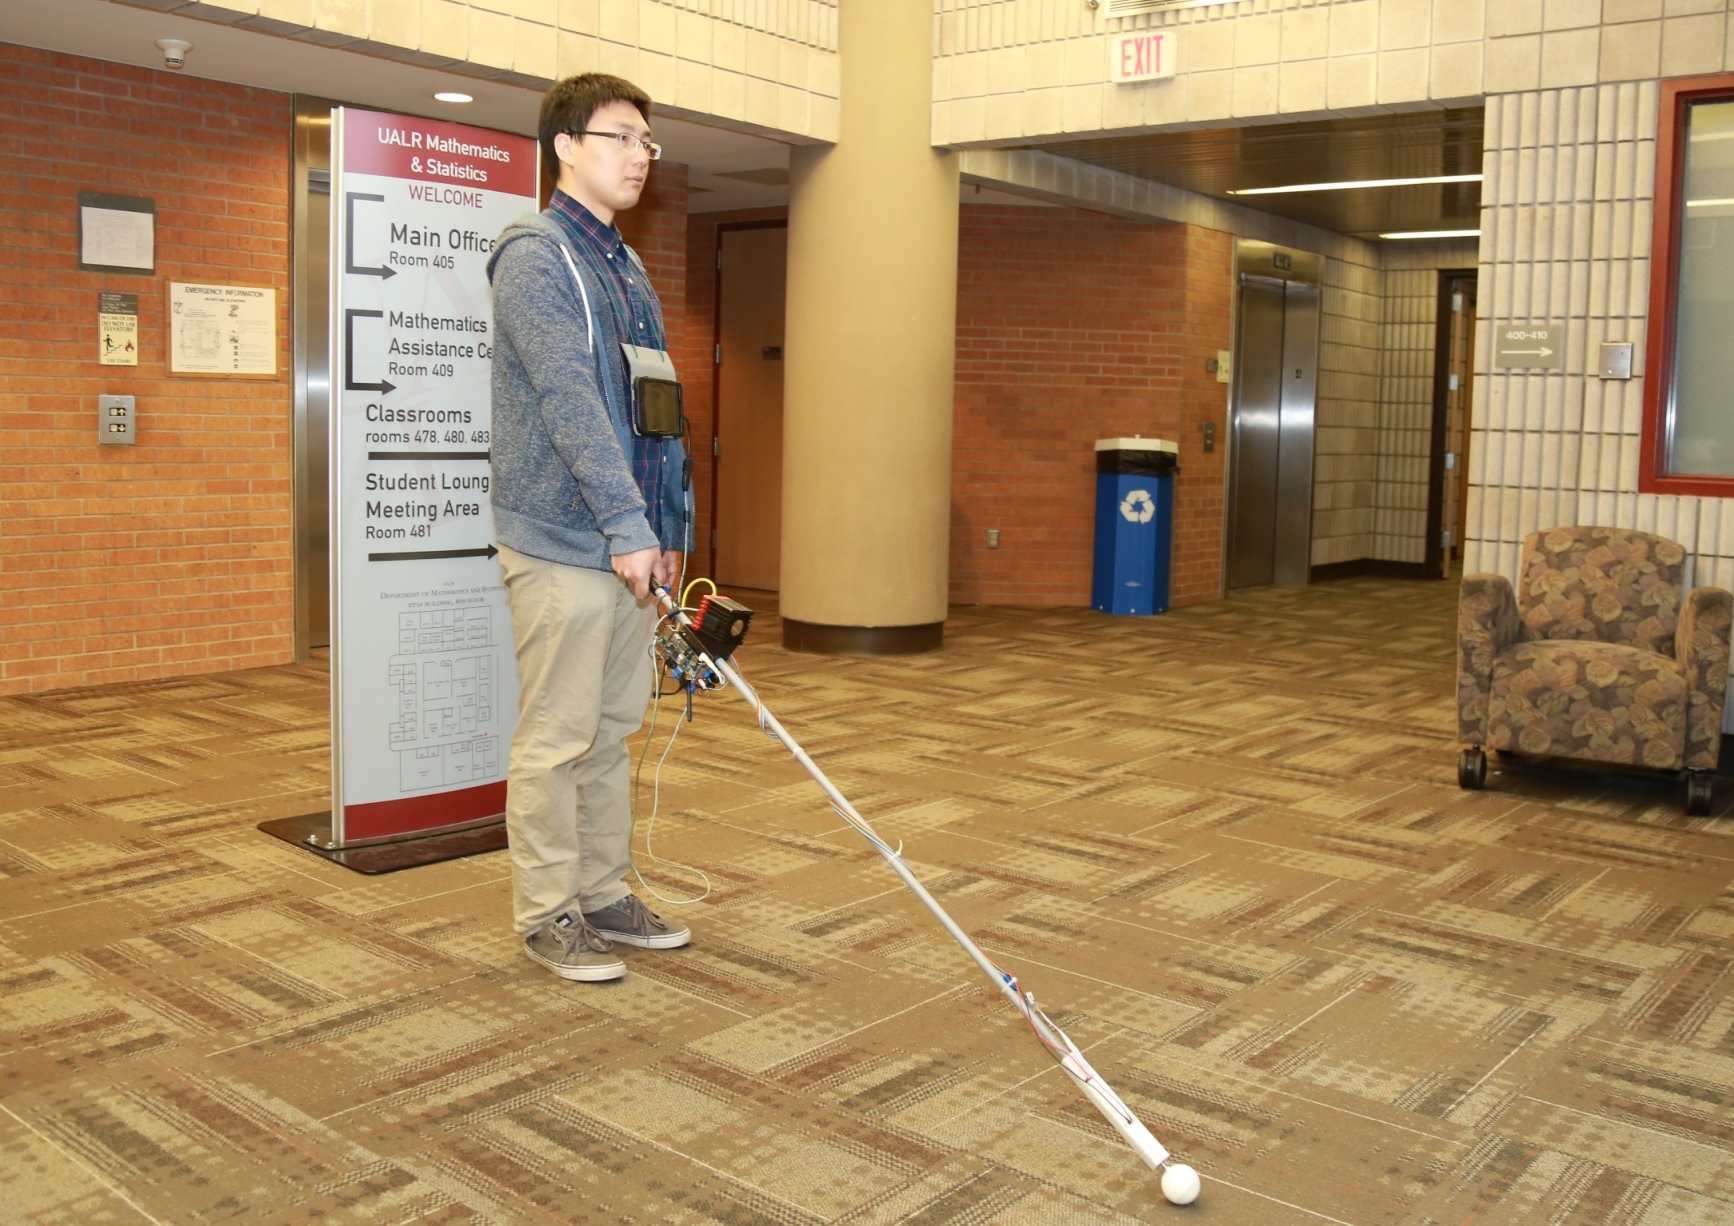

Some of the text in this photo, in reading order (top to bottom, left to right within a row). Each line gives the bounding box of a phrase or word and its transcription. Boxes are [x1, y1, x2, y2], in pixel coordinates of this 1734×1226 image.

[1121, 35, 1164, 77] EXIT
[378, 127, 510, 163] UALR Mathematics
[410, 157, 487, 182] & Statistics
[408, 184, 483, 209] WELCOME
[390, 222, 496, 253] Main Office
[389, 251, 454, 269] Room 405
[185, 286, 263, 298] EMERGENCY INFORMATION
[389, 310, 487, 333] Mathematics
[1505, 330, 1548, 340] 400-410
[388, 337, 473, 358] Assistance
[389, 362, 454, 377] Room 409
[366, 404, 472, 424] Classrooms
[366, 432, 410, 443] rooms
[471, 430, 490, 443] 483
[366, 472, 436, 491] Student
[366, 499, 480, 522] Meeting Area
[366, 525, 431, 540] Room 481
